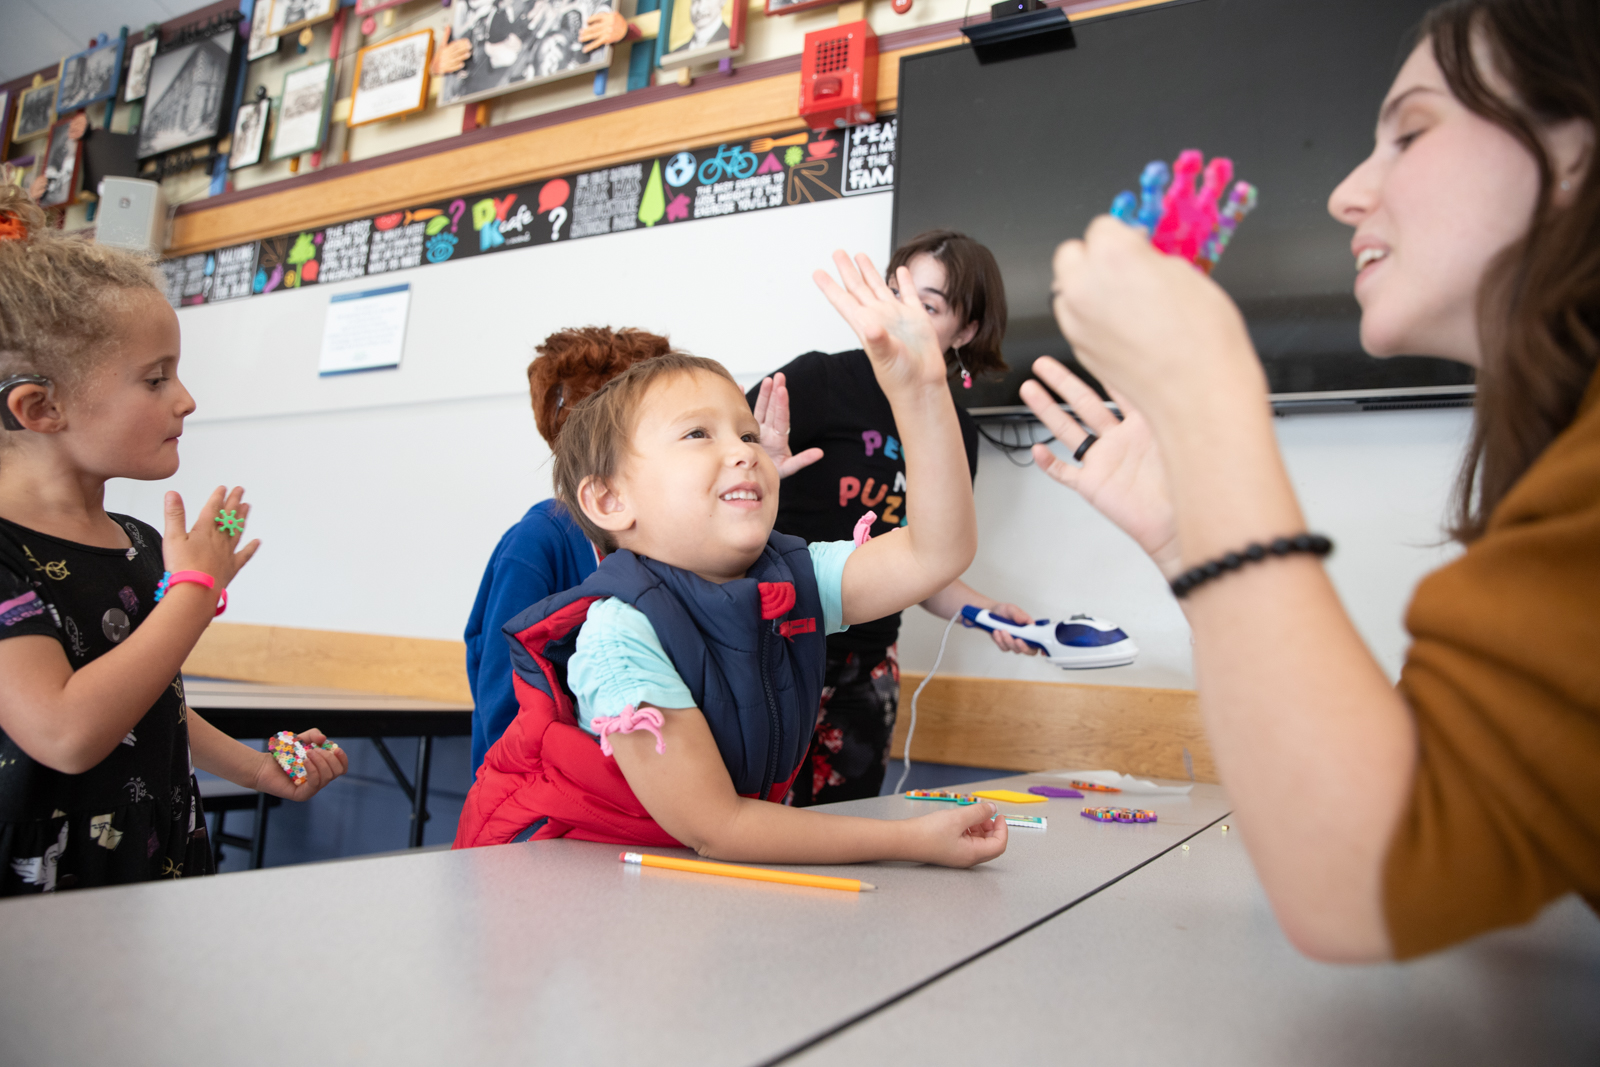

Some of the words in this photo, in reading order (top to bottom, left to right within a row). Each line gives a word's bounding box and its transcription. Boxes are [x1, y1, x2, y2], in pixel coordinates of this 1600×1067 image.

[851, 121, 894, 146] PEA
[850, 144, 869, 157] ARE
[869, 142, 877, 154] A
[878, 140, 895, 154] ME
[849, 156, 866, 171] OF
[866, 153, 890, 169] THE
[696, 184, 712, 196] THE
[713, 180, 734, 195] BEST
[735, 174, 772, 191] EXERCISE
[773, 171, 785, 184] TO
[849, 164, 894, 190] FAM
[574, 182, 610, 205] PARK
[612, 178, 641, 199] WAS
[861, 429, 905, 462] PE
[839, 475, 908, 527] PUZ
